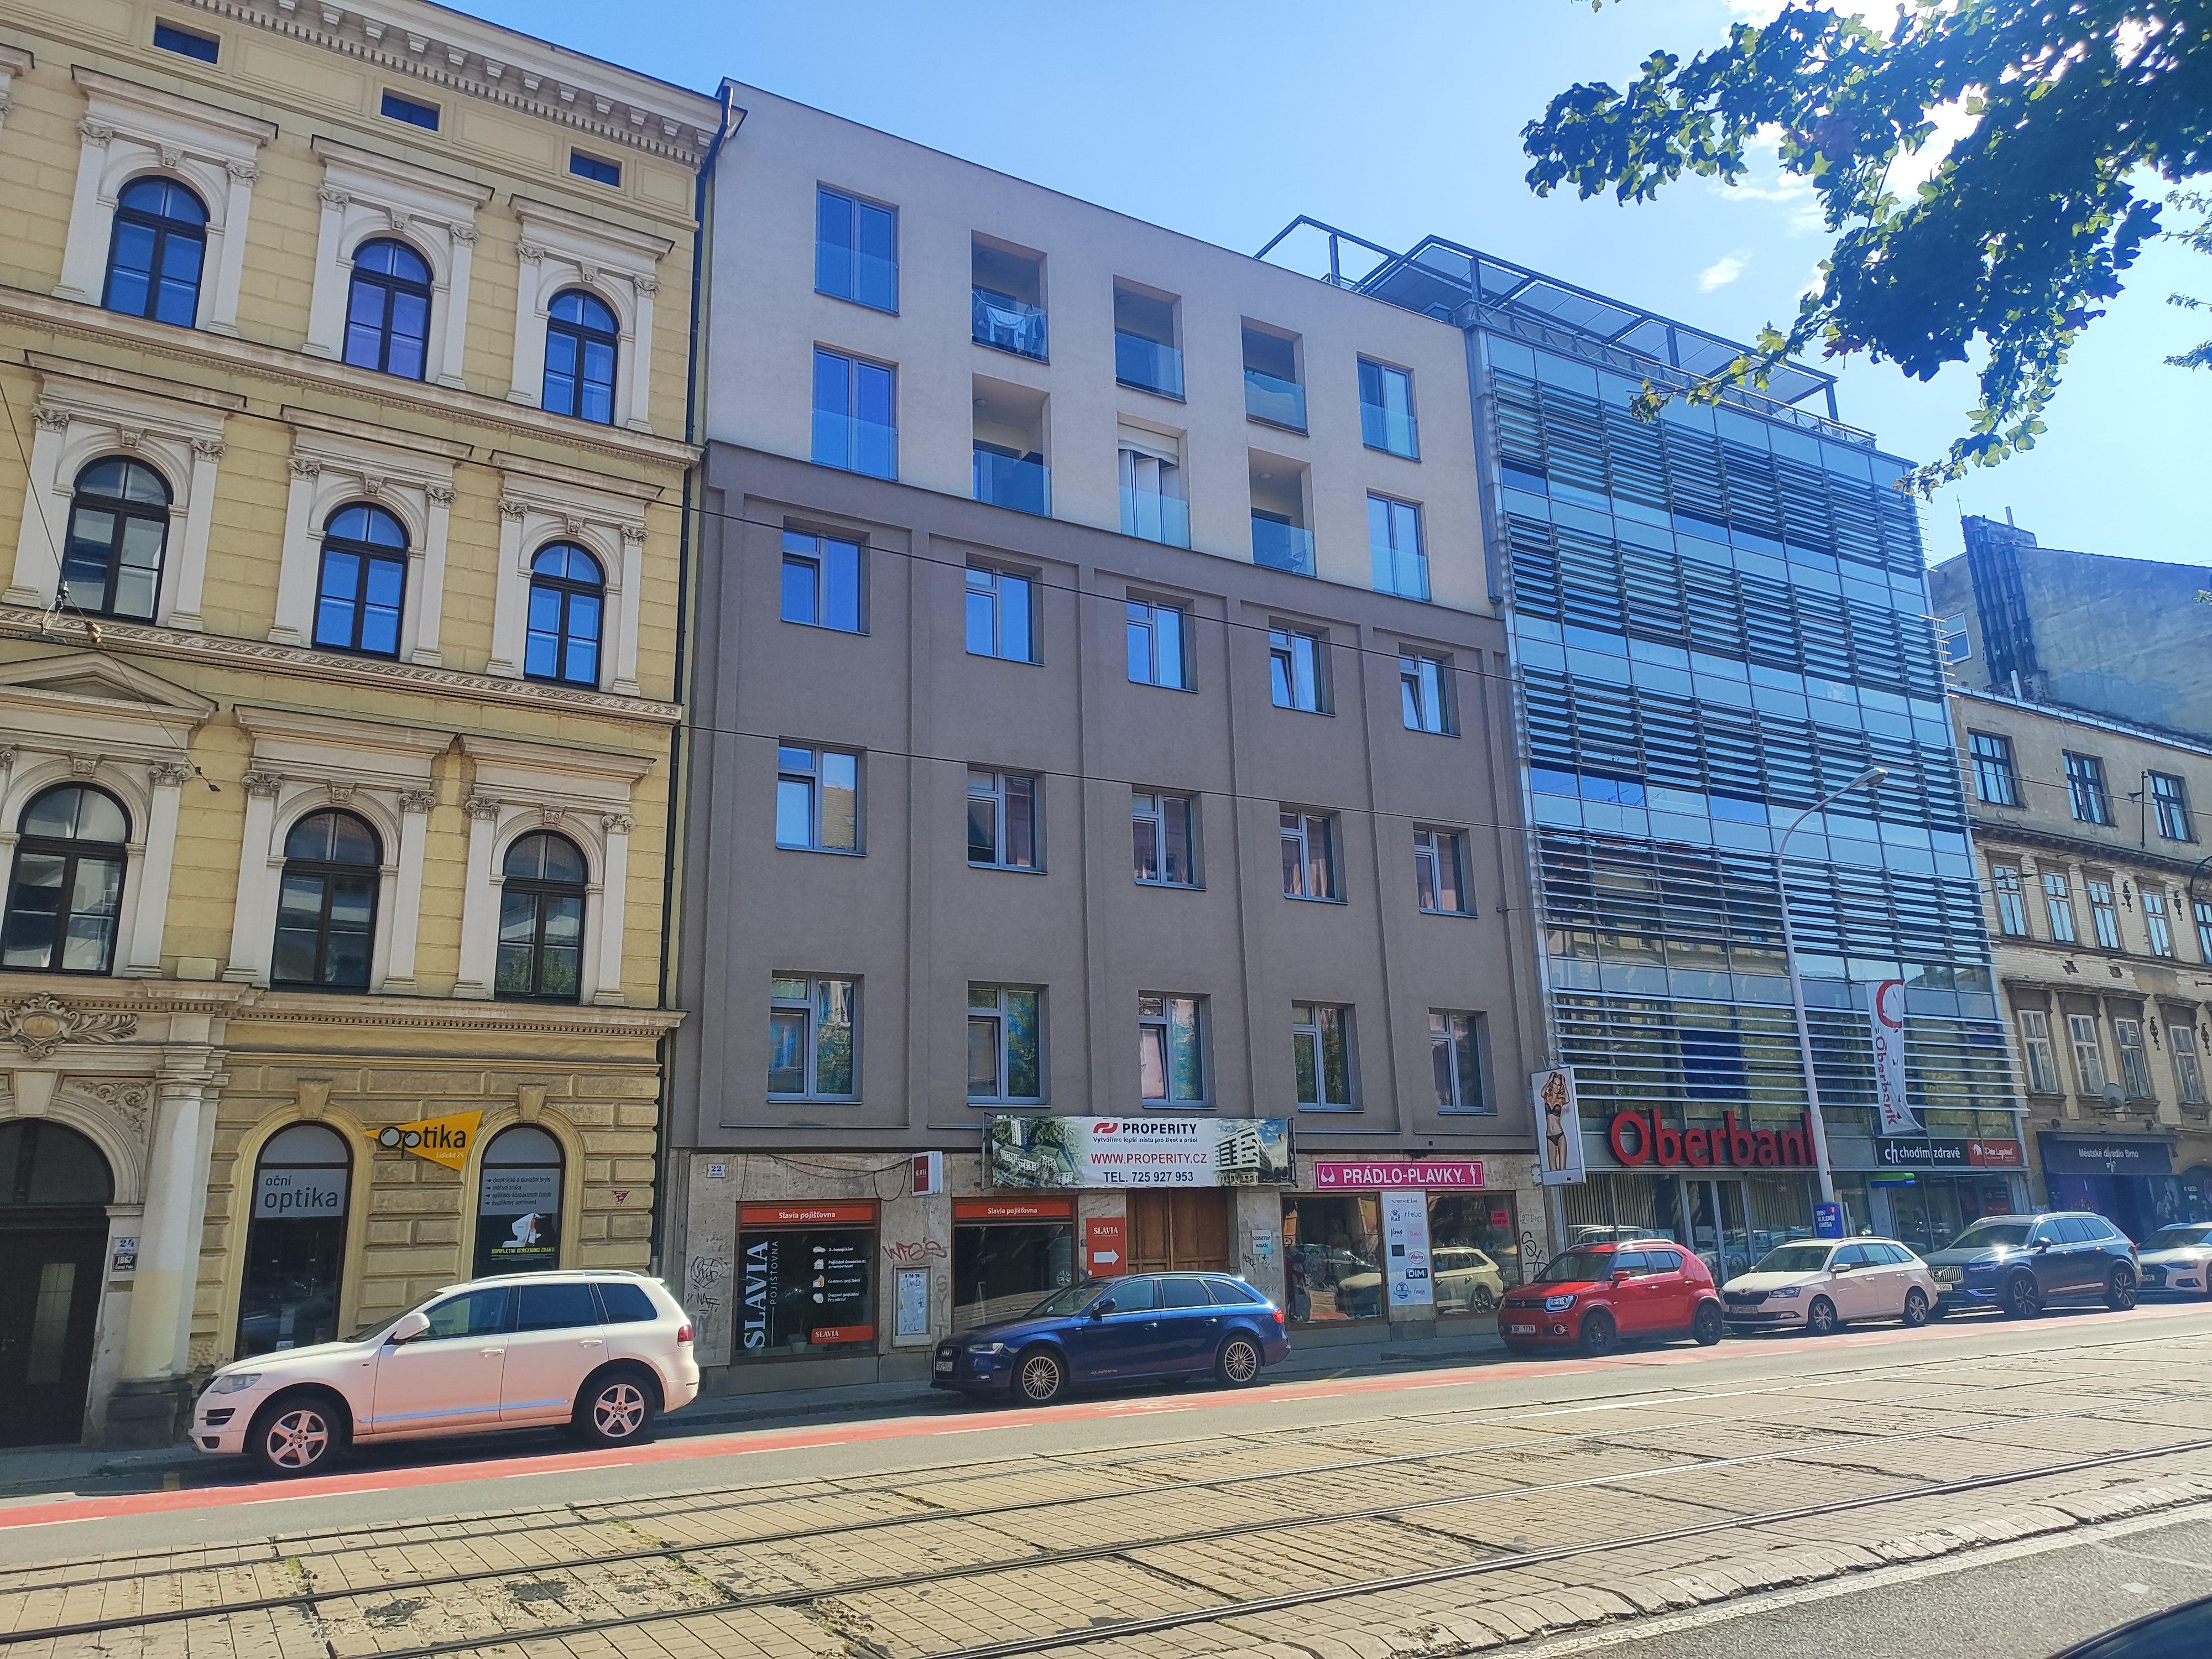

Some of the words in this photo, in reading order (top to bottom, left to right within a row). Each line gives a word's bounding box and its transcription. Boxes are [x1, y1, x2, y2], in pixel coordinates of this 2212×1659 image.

[1122, 1123, 1197, 1134] PROPERITY
[1899, 1146, 1931, 1159] chodím
[1933, 1146, 1961, 1159] zdravě
[2125, 1149, 2139, 1158] Brno
[1091, 1153, 1208, 1164] WWW.PROPERITY.CZ
[265, 1173, 292, 1186] oční
[1103, 1172, 1128, 1182] TEL.
[1131, 1171, 1150, 1182] 725
[1154, 1171, 1172, 1182] 927
[1176, 1171, 1193, 1182] 953
[264, 1187, 338, 1213] optika
[800, 1211, 836, 1220] pojišťovna
[1006, 1207, 1037, 1215] pojišťovna
[119, 1239, 134, 1248] 24
[1408, 1269, 1425, 1277] DIM
[744, 1241, 768, 1348] SLAVIA
